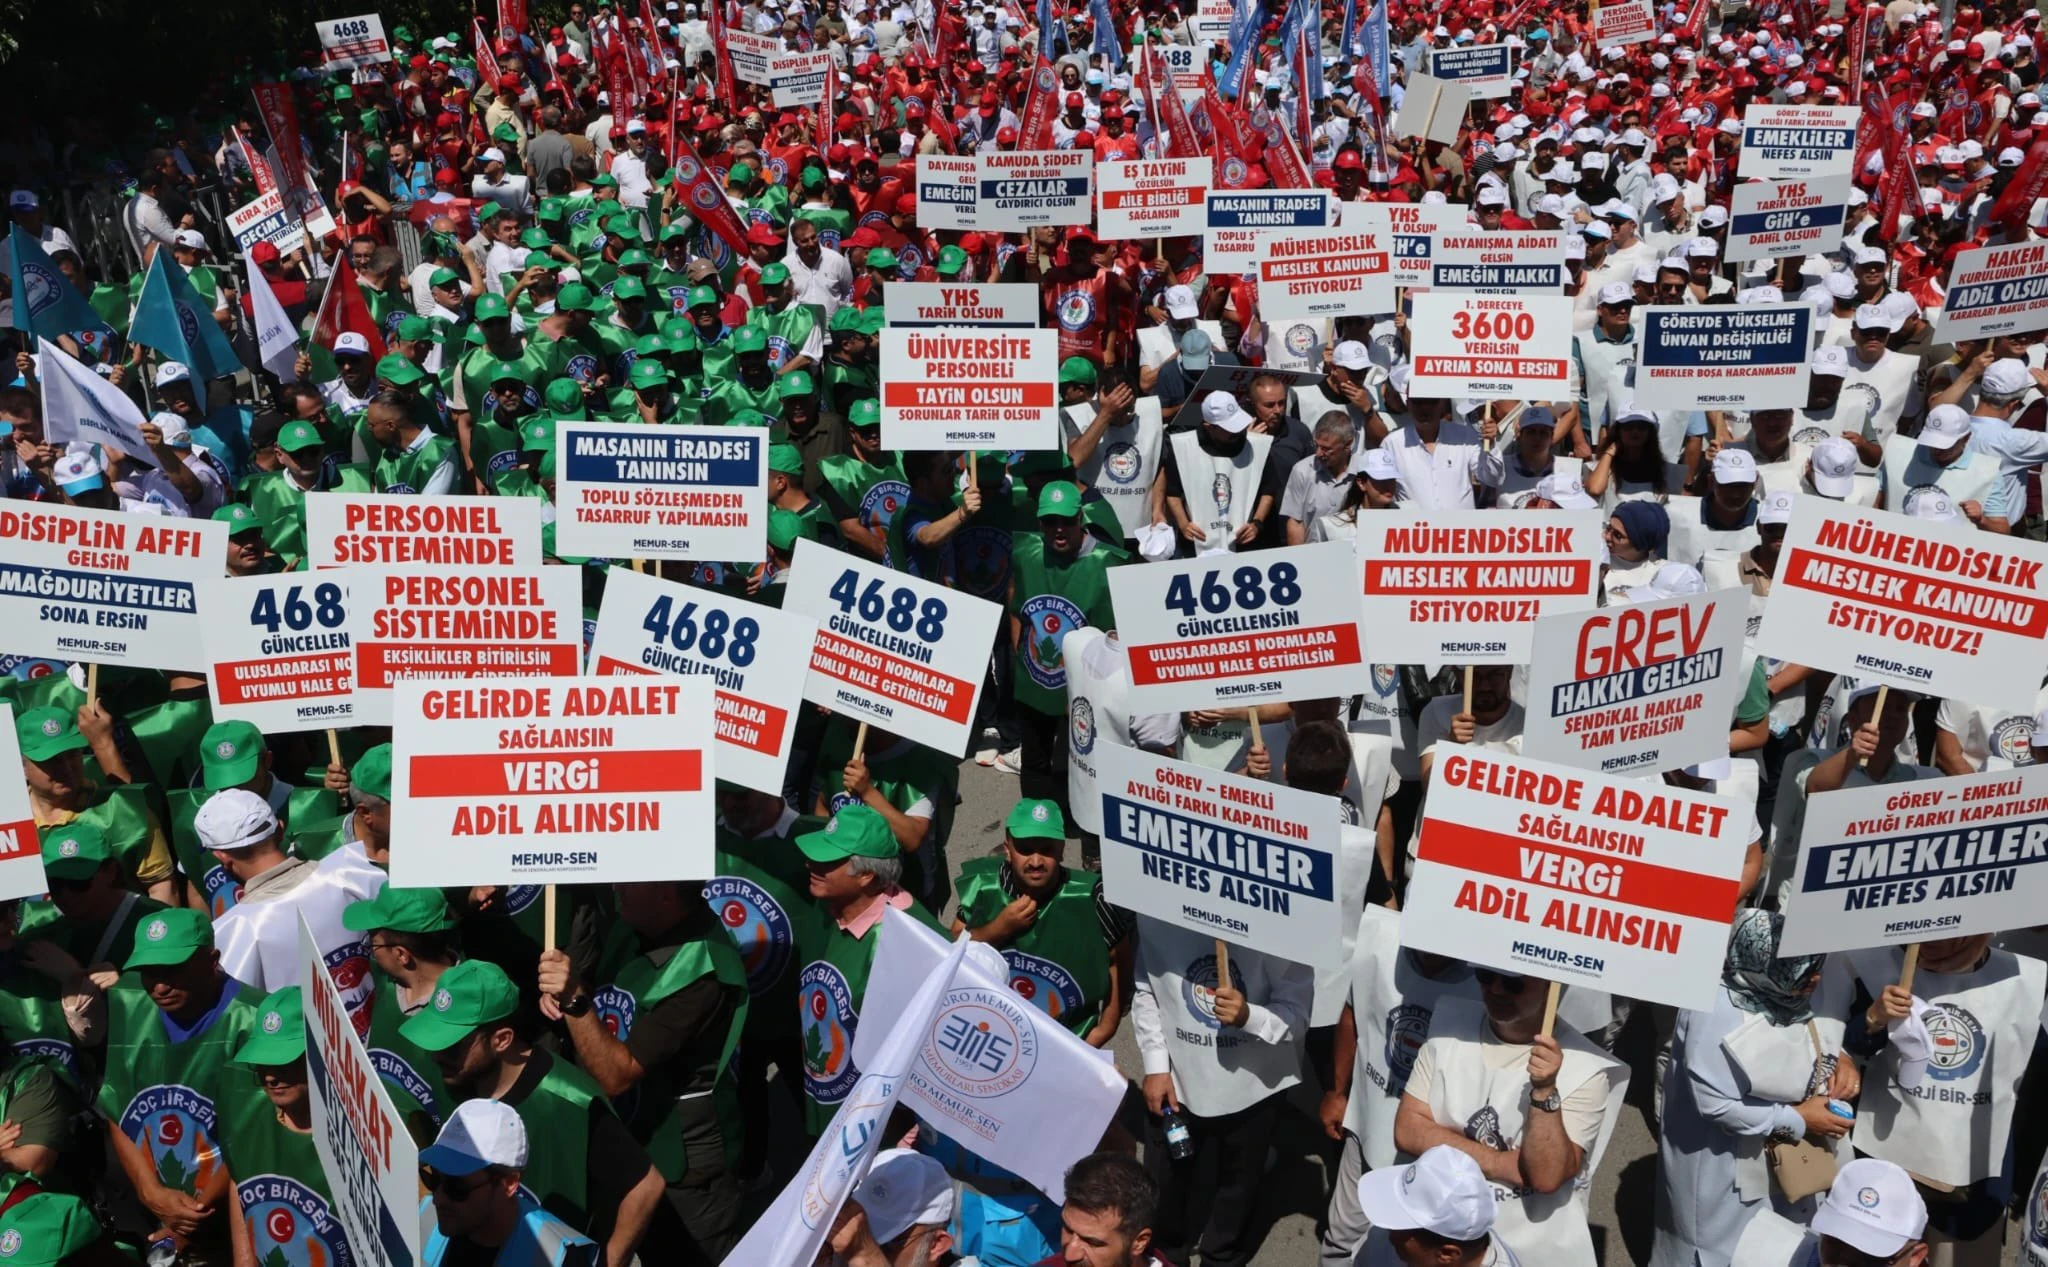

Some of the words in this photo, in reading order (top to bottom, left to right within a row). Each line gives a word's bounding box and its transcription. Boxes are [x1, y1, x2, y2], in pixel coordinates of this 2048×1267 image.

[334, 20, 368, 37] 4688
[761, 39, 777, 51] AFFI
[986, 155, 1039, 168] KAMUDA
[1761, 149, 1797, 160] NEFES
[1799, 150, 1833, 161] ALSIN
[1010, 169, 1027, 178] SON
[1029, 169, 1062, 178] BULSUN
[1124, 165, 1139, 180] EŞ
[925, 185, 975, 202] EMEĞİN
[996, 180, 1068, 197] CEZALAR
[1777, 183, 1807, 197] YHS
[995, 199, 1043, 209] CAYDIRICI
[1046, 197, 1077, 208] OLSUN
[1212, 199, 1272, 212] MASANIN
[1791, 196, 1822, 207] OLSUN
[1129, 208, 1180, 221] SAĞLANSIN
[1237, 213, 1295, 226] TANINSIN
[1389, 207, 1420, 223] YHS
[1217, 231, 1245, 242] TOPLU
[1443, 238, 1514, 251] DAYANIŞMA
[1783, 228, 1822, 242] OLSUN!
[1270, 262, 1320, 278] MESLEK
[1323, 256, 1381, 274] KANUNU
[1986, 245, 2046, 269] HAKEM
[1439, 263, 1497, 284] EMEĞİN
[1503, 268, 1556, 283] HAKKI
[1958, 264, 2027, 285] KURULUNUN
[940, 288, 980, 307] YHS
[961, 306, 1004, 319] OLSUN
[1659, 314, 1723, 328] GÖREVDE
[1726, 312, 1796, 327] YÜKSELME
[1949, 307, 1996, 320] KARARLARI
[1998, 303, 2027, 315] MAKUL
[1452, 311, 1536, 340] 3600
[908, 333, 1031, 360] ÜNİVERSİTE
[1660, 332, 1708, 347] ÜNVAN
[1699, 349, 1752, 361] YAPILSIN
[1424, 360, 1472, 374] AYRIM
[1475, 361, 1514, 375] SONA
[1650, 368, 1695, 378] EMEKLER
[1697, 367, 1723, 379] BOŞA
[1725, 366, 1796, 377] HARCANMASIN
[971, 387, 1023, 404] OLSUN
[899, 409, 961, 421] SORUNLAR
[1003, 408, 1041, 421] OLSUN
[946, 431, 996, 440] MEMUR-SEN
[575, 437, 668, 458] MASANIN
[616, 460, 709, 481] TANINSIN
[582, 489, 630, 505] TOPLU
[635, 488, 743, 510] SÖZLEŞMEDEN
[345, 504, 503, 534] PERSONEL
[576, 508, 652, 525] TASARRUF
[656, 511, 749, 528] YAPILMASIN
[136, 526, 202, 558] AFFI
[633, 538, 690, 549] MEMUR-SEN
[1379, 566, 1468, 588] MESLEK
[1476, 565, 1575, 588] KANUNU
[0, 570, 193, 610] MAĞDURİYETLER
[385, 576, 545, 606] PERSONEL
[1165, 562, 1302, 617] 4688
[1802, 559, 1910, 603] MESLEK
[1913, 583, 2035, 627] KANUNU
[40, 604, 90, 625] SONA
[828, 568, 949, 643] 4688
[1023, 599, 1044, 617] TOÇ
[1046, 598, 1086, 629] BİR-SEN
[642, 594, 760, 668] 4688
[1177, 608, 1300, 638] GÜNCELLENSİN
[57, 636, 127, 653] MEMUR-SEN
[828, 614, 933, 665] GÜNCELLENSİN
[1149, 640, 1251, 663] ULUSLARARASI
[1255, 631, 1337, 653] NORMLARA
[1441, 642, 1507, 652] MEMUR-SEN
[1575, 602, 1717, 682] GREV
[234, 658, 331, 681] ULUSLARARASI
[1156, 662, 1215, 681] UYUMLU
[1219, 658, 1255, 674] HALE
[1258, 647, 1335, 671] GETİRİLSİN
[1855, 653, 1934, 680] MEMUR-SEN
[241, 680, 297, 699] UYUMLU
[301, 678, 334, 694] HALE
[884, 660, 955, 697] NORMLARA
[1215, 681, 1283, 696] MEMUR-SEN
[562, 685, 681, 718] ADALET
[848, 667, 878, 690] HALE
[881, 678, 948, 714] GETİRİLSİN
[1556, 673, 1634, 715] HAKKI
[836, 688, 894, 719] MEMUR-SEN
[1643, 693, 1704, 721] HAKLAR
[498, 723, 614, 750] SAĞLANSIN
[1581, 725, 1616, 751] TAM
[1601, 749, 1660, 771] MEMUR-SEN
[534, 801, 660, 835] ALINSIN
[1127, 780, 1171, 808] AYLIĞI
[1175, 795, 1217, 818] FARKI
[1222, 806, 1309, 841] KAPATILSIN
[1592, 785, 1729, 839] ADALET
[1844, 813, 1900, 837] AYLIĞI
[1904, 806, 1955, 830] FARKI
[1517, 813, 1645, 857] SAĞLANSIN
[511, 851, 598, 866] MEMUR-SEN
[206, 871, 227, 892] TOÇ
[1142, 852, 1211, 894] NEFES
[1219, 875, 1290, 917] ALSIN
[1844, 879, 1929, 912] NEFES
[1936, 868, 2017, 901] ALSIN
[1183, 904, 1249, 933] MEMUR-SEN
[1541, 899, 1683, 955] ALINSIN
[1884, 914, 1962, 933] MEMUR-SEN
[1511, 940, 1605, 972] MEMUR-SEN
[1014, 955, 1068, 989] BİR-SEN
[311, 959, 393, 1173] MÜLAKAT
[379, 1059, 433, 1106] BİR-SEN
[270, 1184, 332, 1235] BİR-SEN
